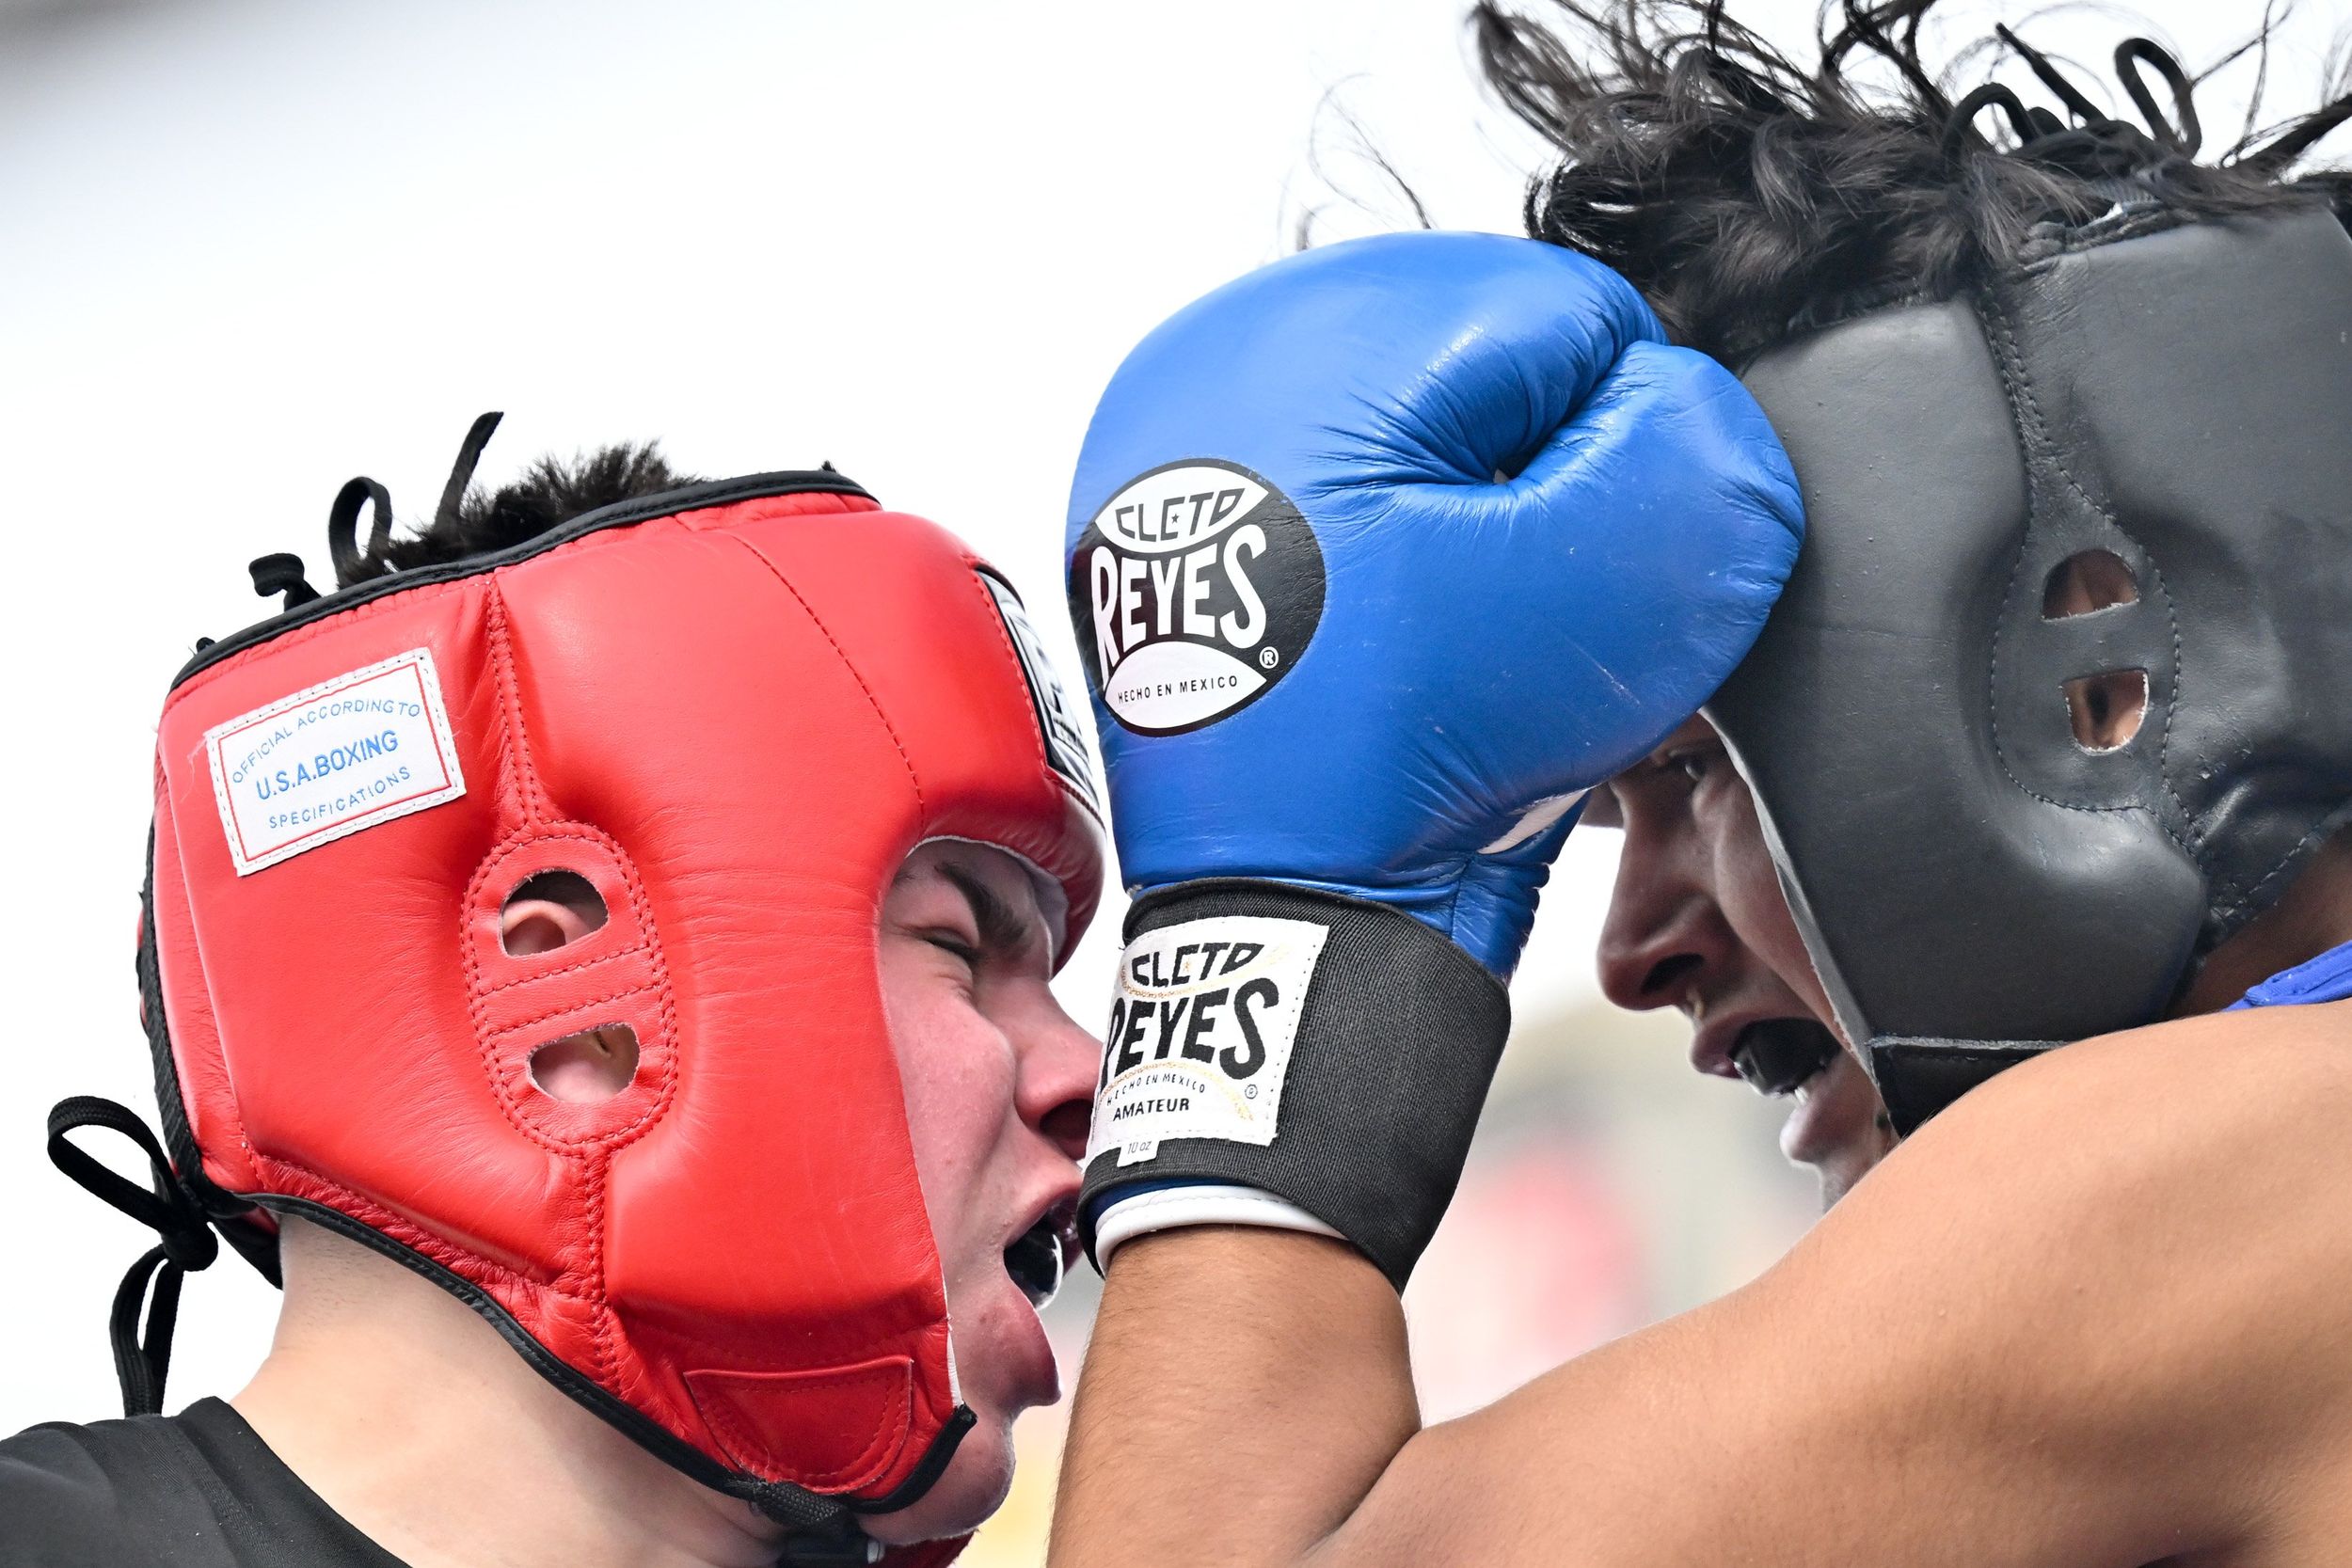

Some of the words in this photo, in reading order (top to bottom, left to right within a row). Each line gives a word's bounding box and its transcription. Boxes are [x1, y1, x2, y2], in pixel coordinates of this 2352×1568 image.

[1115, 487, 1246, 542] CLETO
[1090, 524, 1267, 692] REYES
[1118, 687, 1151, 705] HECHO
[1157, 683, 1172, 697] EN
[1179, 675, 1238, 694] MEXICO
[232, 726, 293, 784] OFFICIAL
[297, 699, 393, 730] ACCORDING
[398, 702, 421, 718] TO
[268, 767, 411, 829] SPECIFICATIONS
[1131, 942, 1265, 988] CLETO
[1100, 977, 1279, 1095] REYES
[1106, 1077, 1141, 1106] HECHO
[1146, 1074, 1158, 1085] EN
[1162, 1072, 1205, 1093] MEXICO
[1113, 1098, 1190, 1122] AMATEUR
